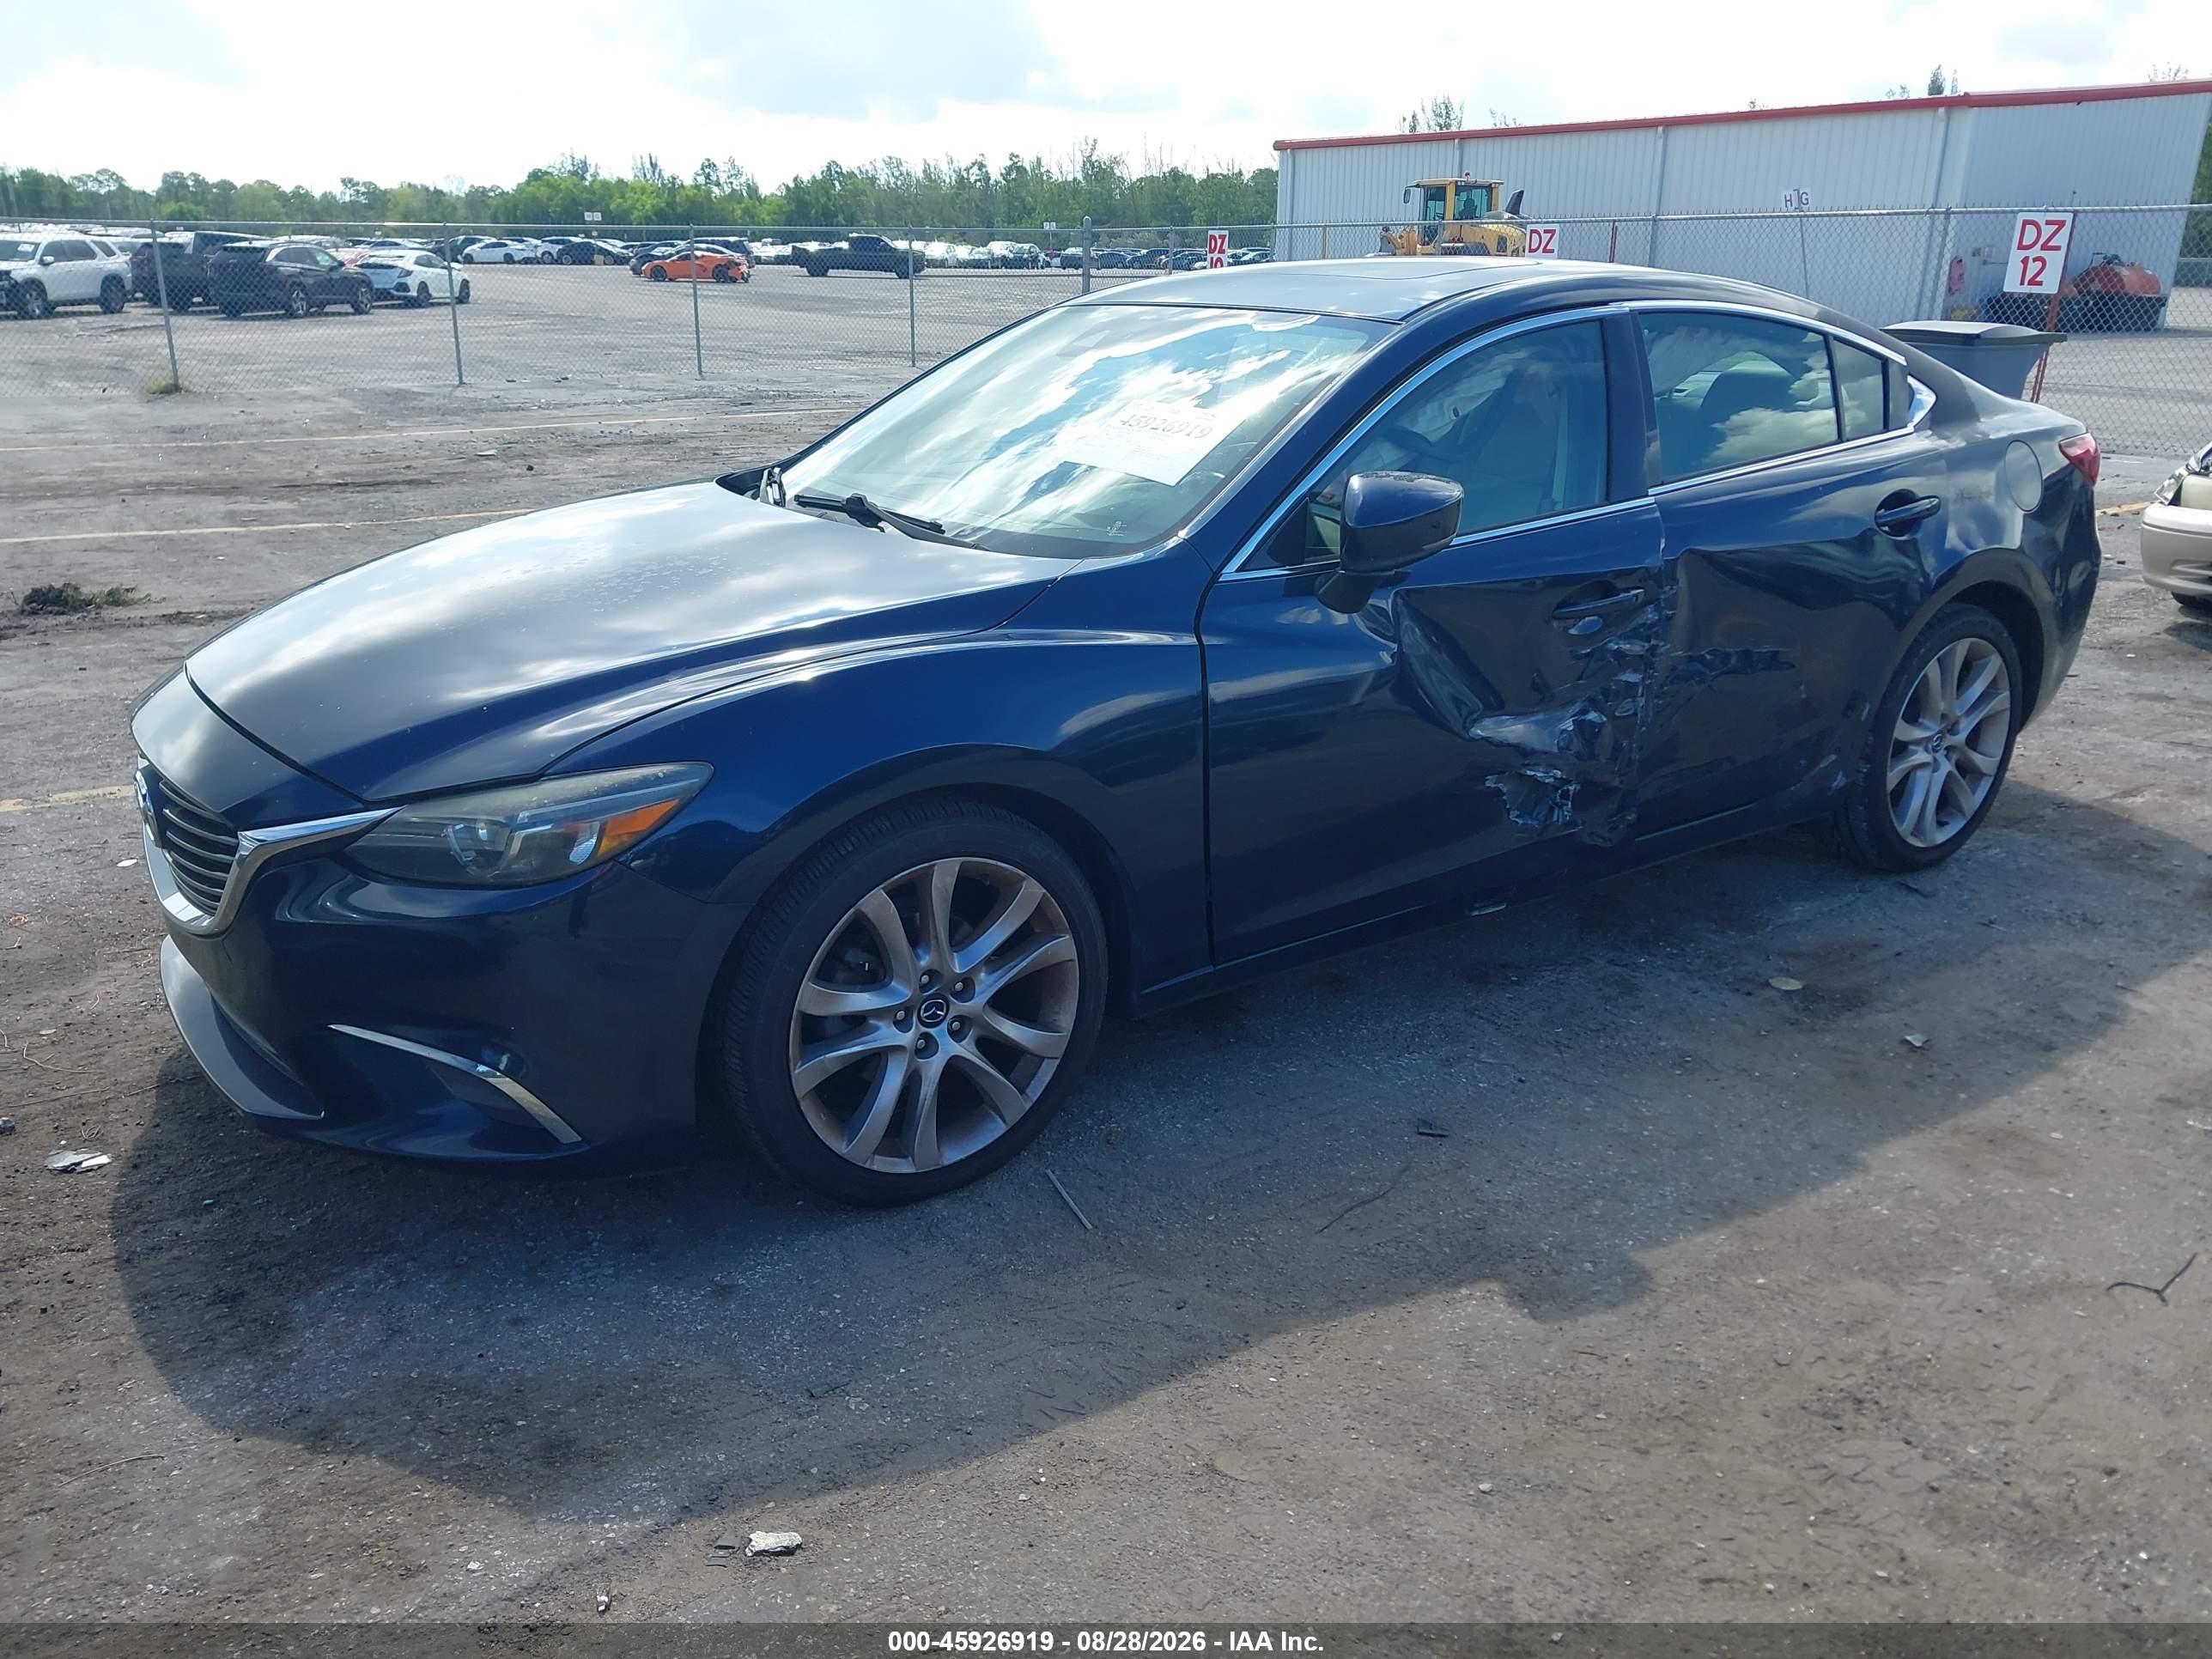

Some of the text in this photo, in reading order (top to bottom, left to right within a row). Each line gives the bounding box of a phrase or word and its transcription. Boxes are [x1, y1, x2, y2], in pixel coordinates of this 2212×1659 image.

[1784, 191, 1809, 209] H G
[1208, 234, 1228, 255] DZ
[1528, 228, 1557, 254] DZ
[2016, 218, 2067, 252] DZ
[2019, 255, 2048, 287] 12
[1120, 414, 1214, 440] 45926919
